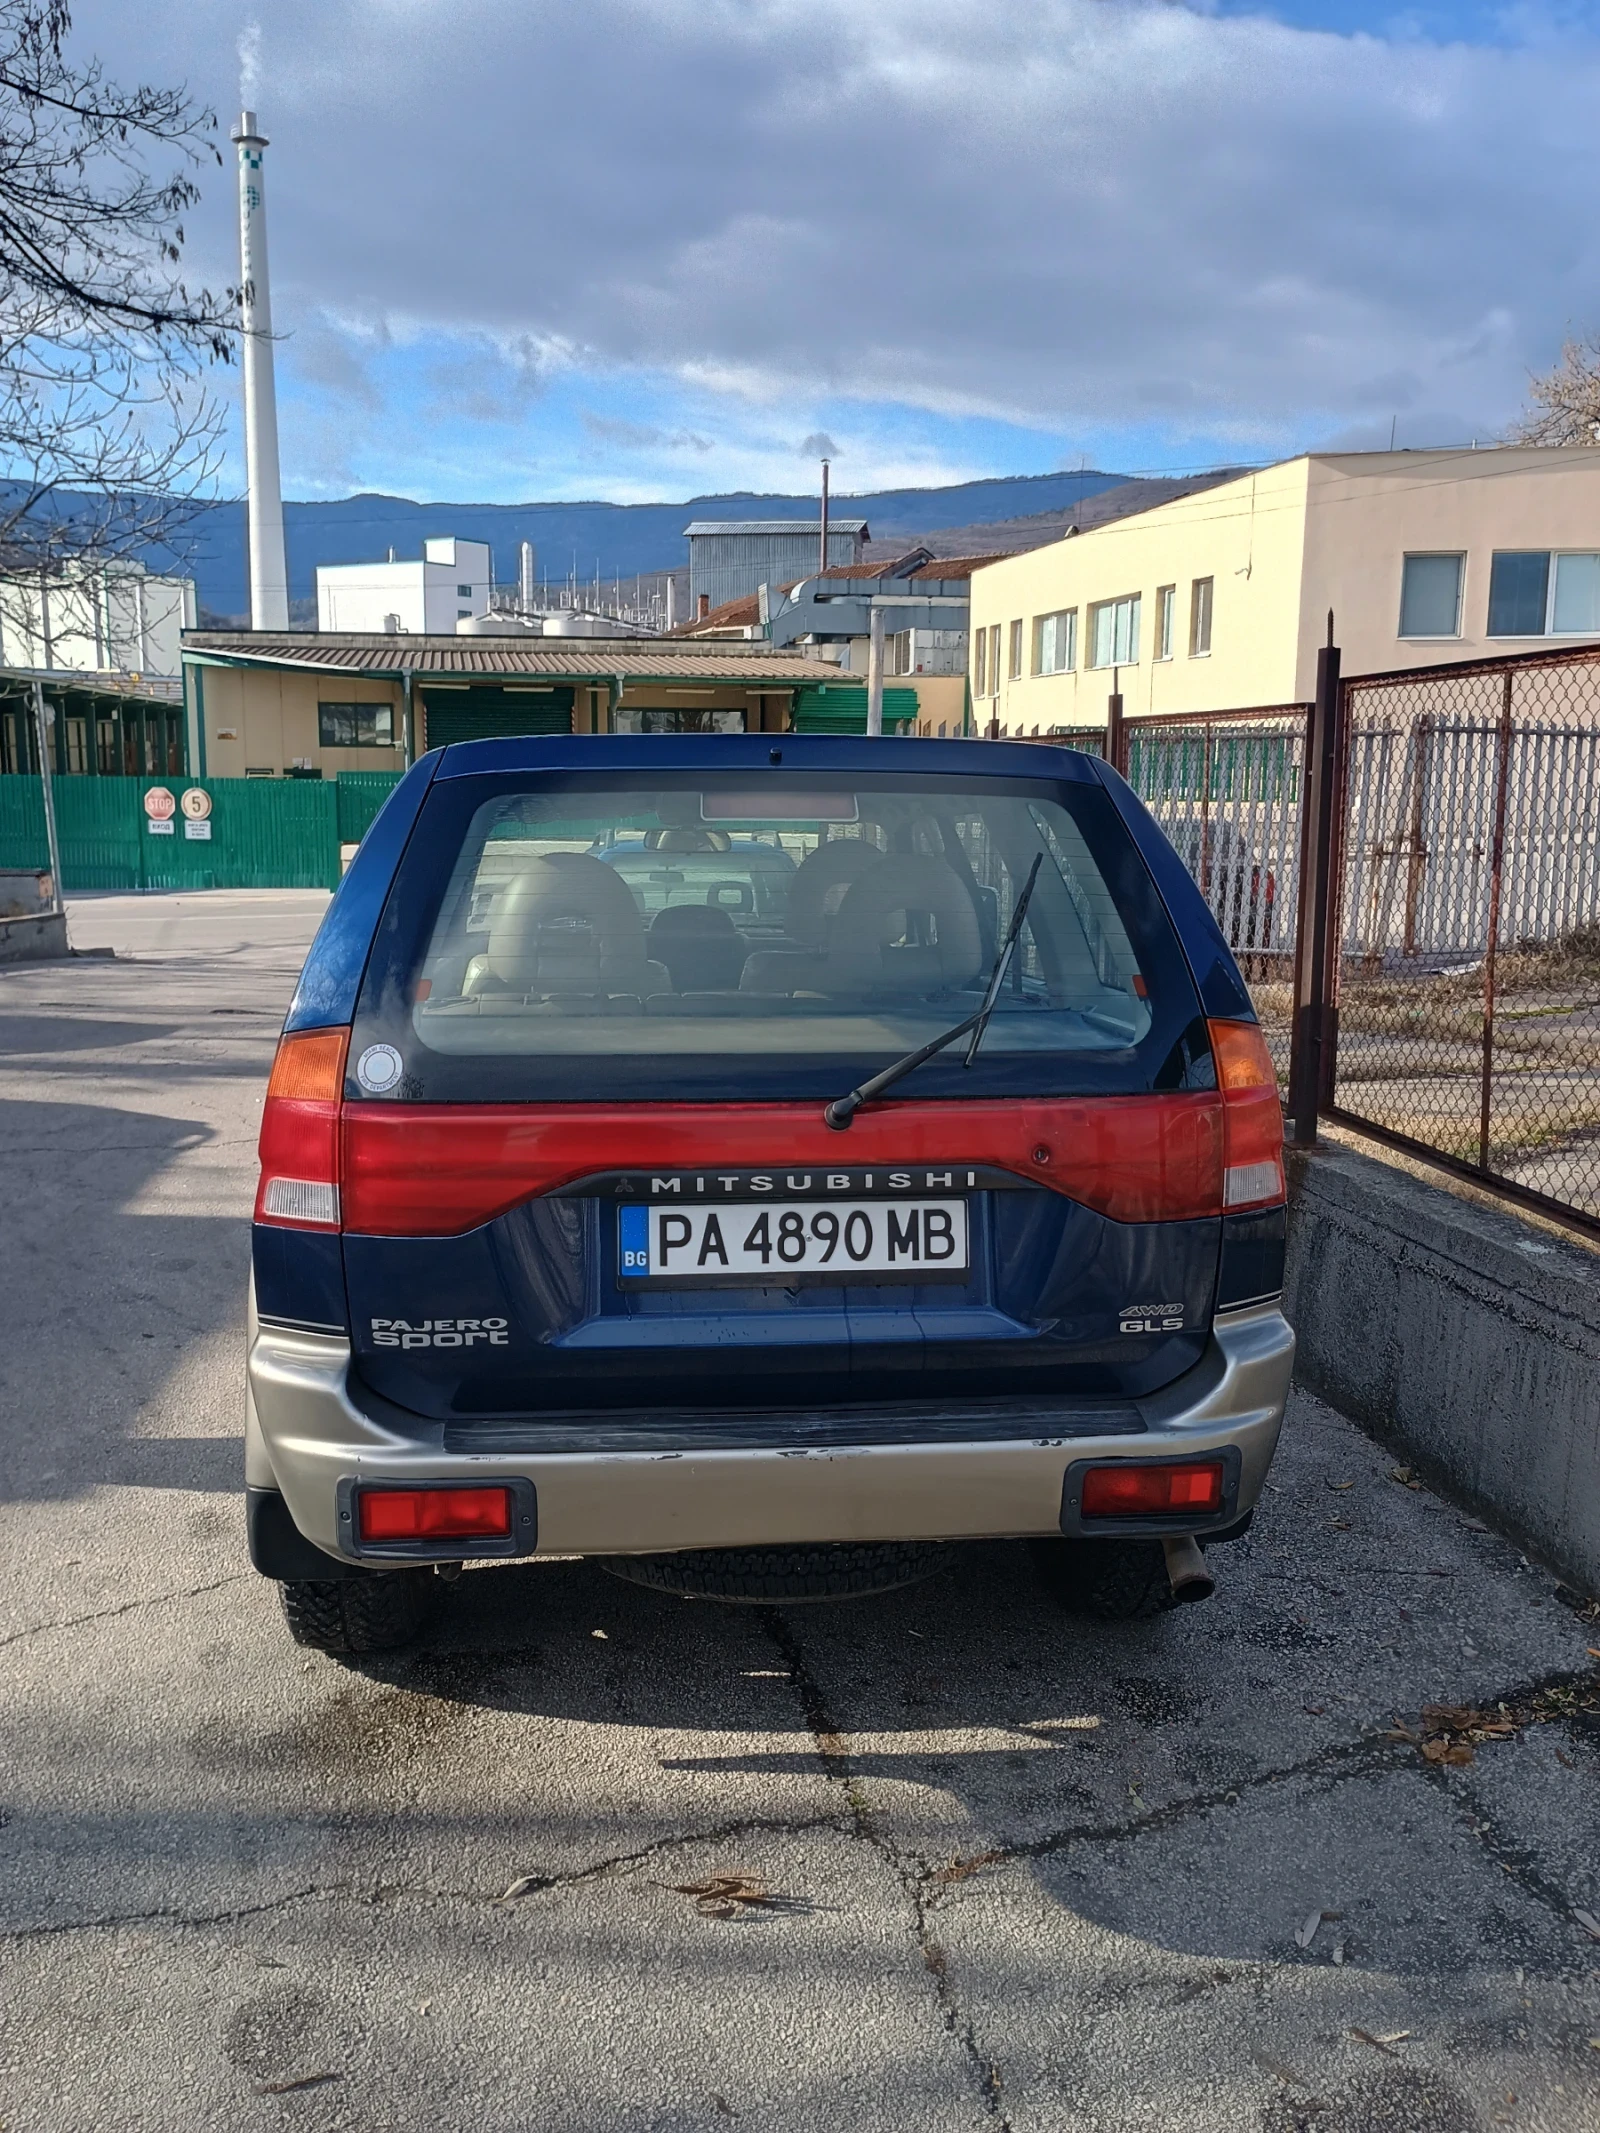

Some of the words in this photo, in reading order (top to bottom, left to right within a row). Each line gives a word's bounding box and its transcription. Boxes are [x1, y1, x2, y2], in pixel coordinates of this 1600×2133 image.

[148, 798, 172, 810] STOP
[192, 796, 201, 813] 5
[363, 1046, 377, 1058] MIAMI
[379, 1045, 396, 1055] BEACH
[360, 1075, 370, 1086] FIRE
[370, 1072, 399, 1090] DEPARTMENT
[651, 1171, 976, 1193] MITSUBISHI
[659, 1213, 730, 1267] PA
[743, 1210, 873, 1265] 4890
[887, 1208, 956, 1262] MB
[624, 1250, 647, 1267] BG
[371, 1317, 508, 1332] PAJERO
[1119, 1318, 1184, 1333] GLS
